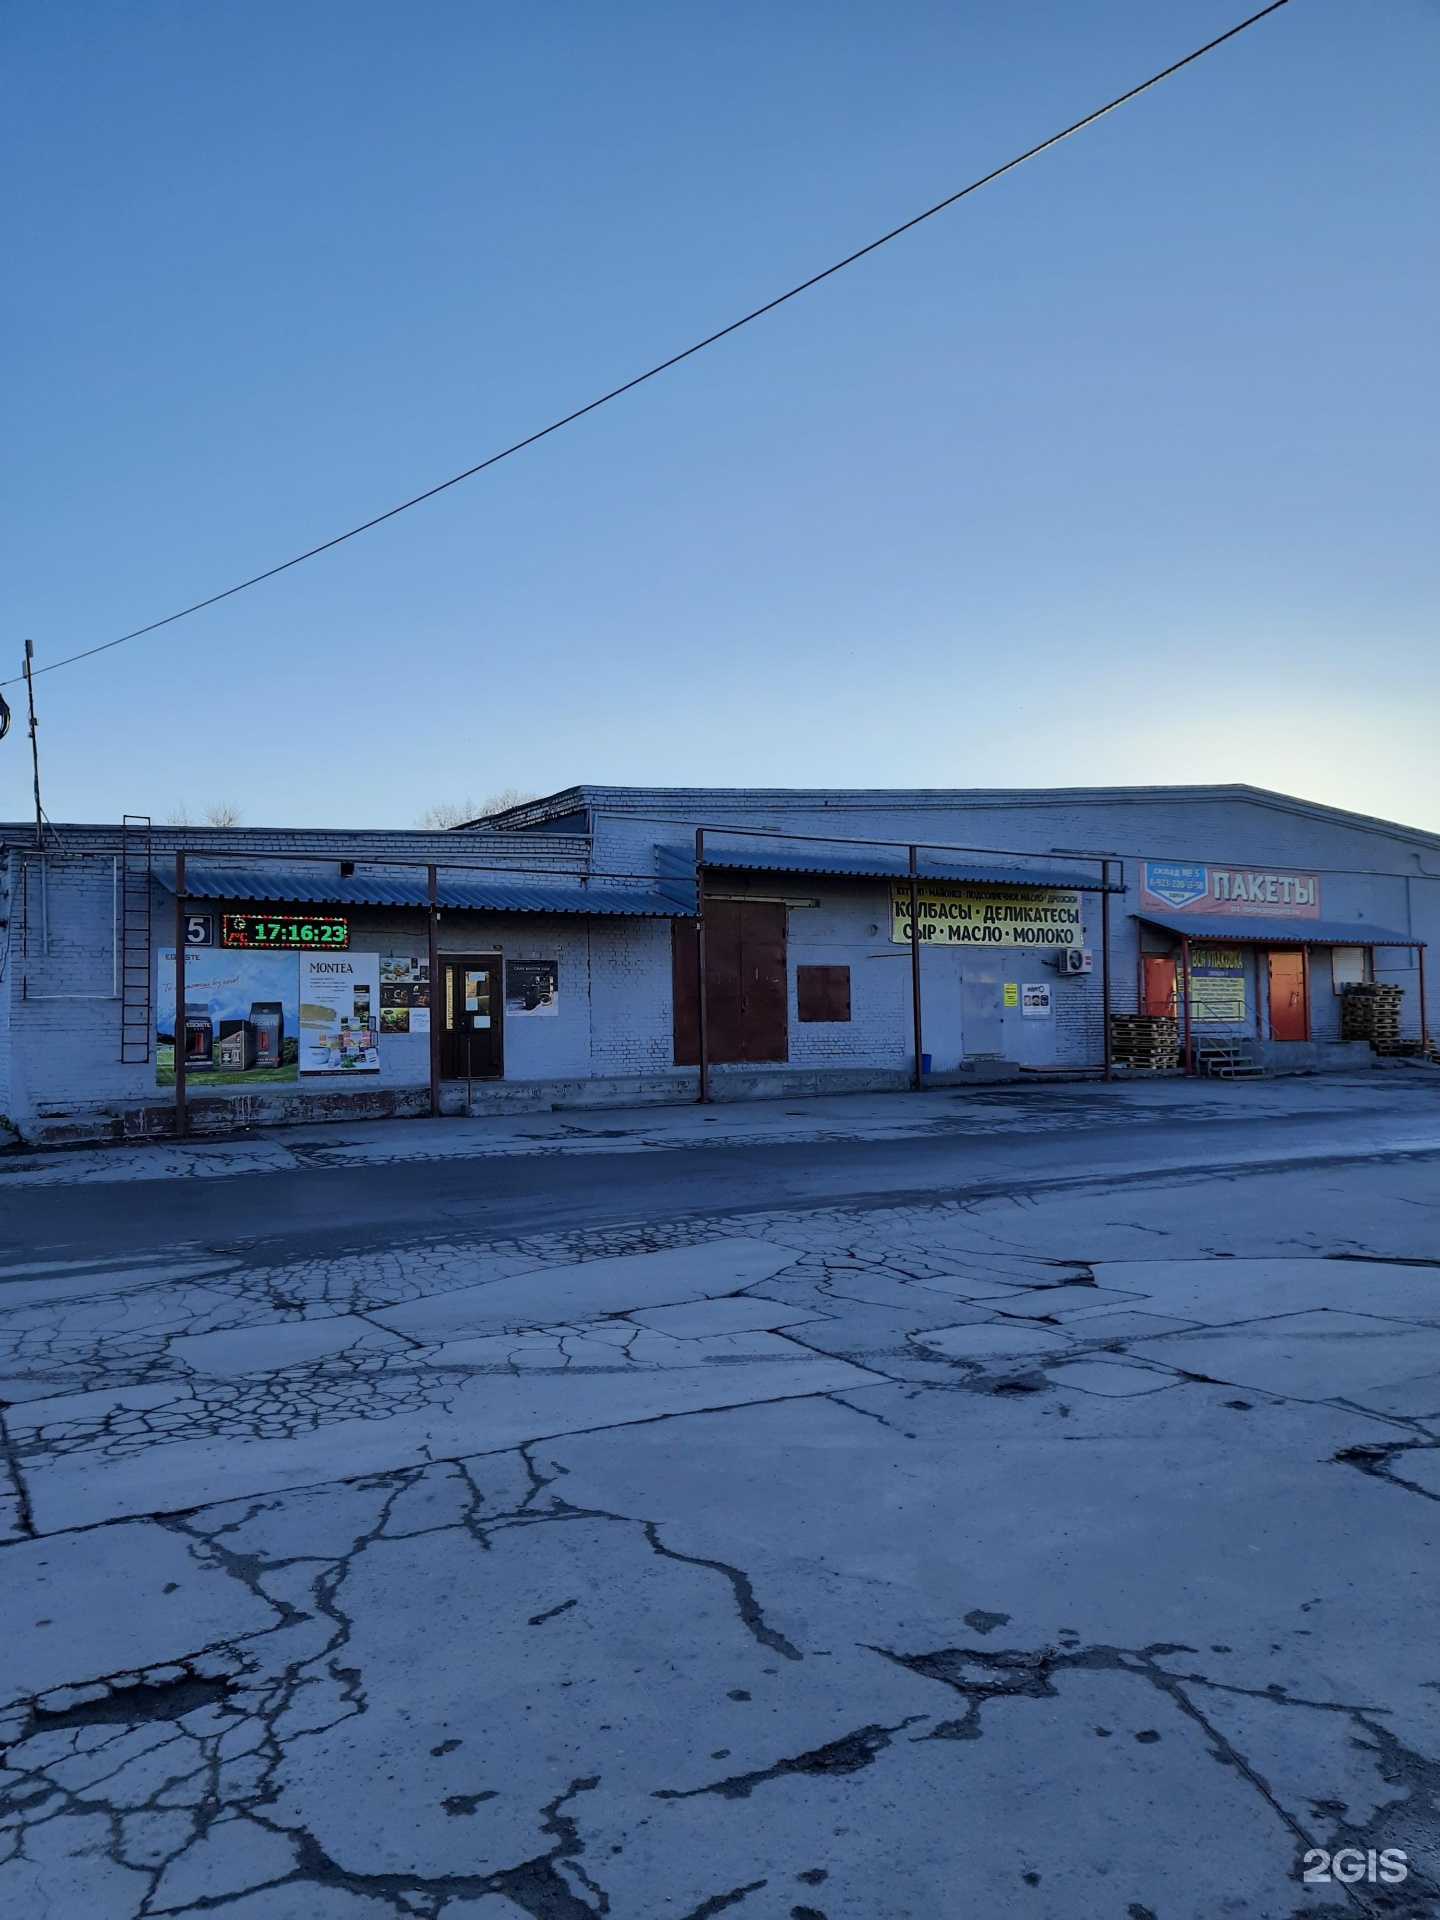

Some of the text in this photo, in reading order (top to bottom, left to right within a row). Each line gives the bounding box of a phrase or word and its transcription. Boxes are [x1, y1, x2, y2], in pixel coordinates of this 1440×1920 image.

[1212, 871, 1316, 906] ПАКЕТЫ
[895, 901, 1080, 924] КОЛБАСЫ ДЕЛИКАТЕСЫ
[187, 918, 205, 942] 5
[255, 923, 345, 942] 17:16:23
[903, 923, 1073, 944] СЫР МАСЛО МОЛОКО
[164, 953, 201, 961] EGSTE
